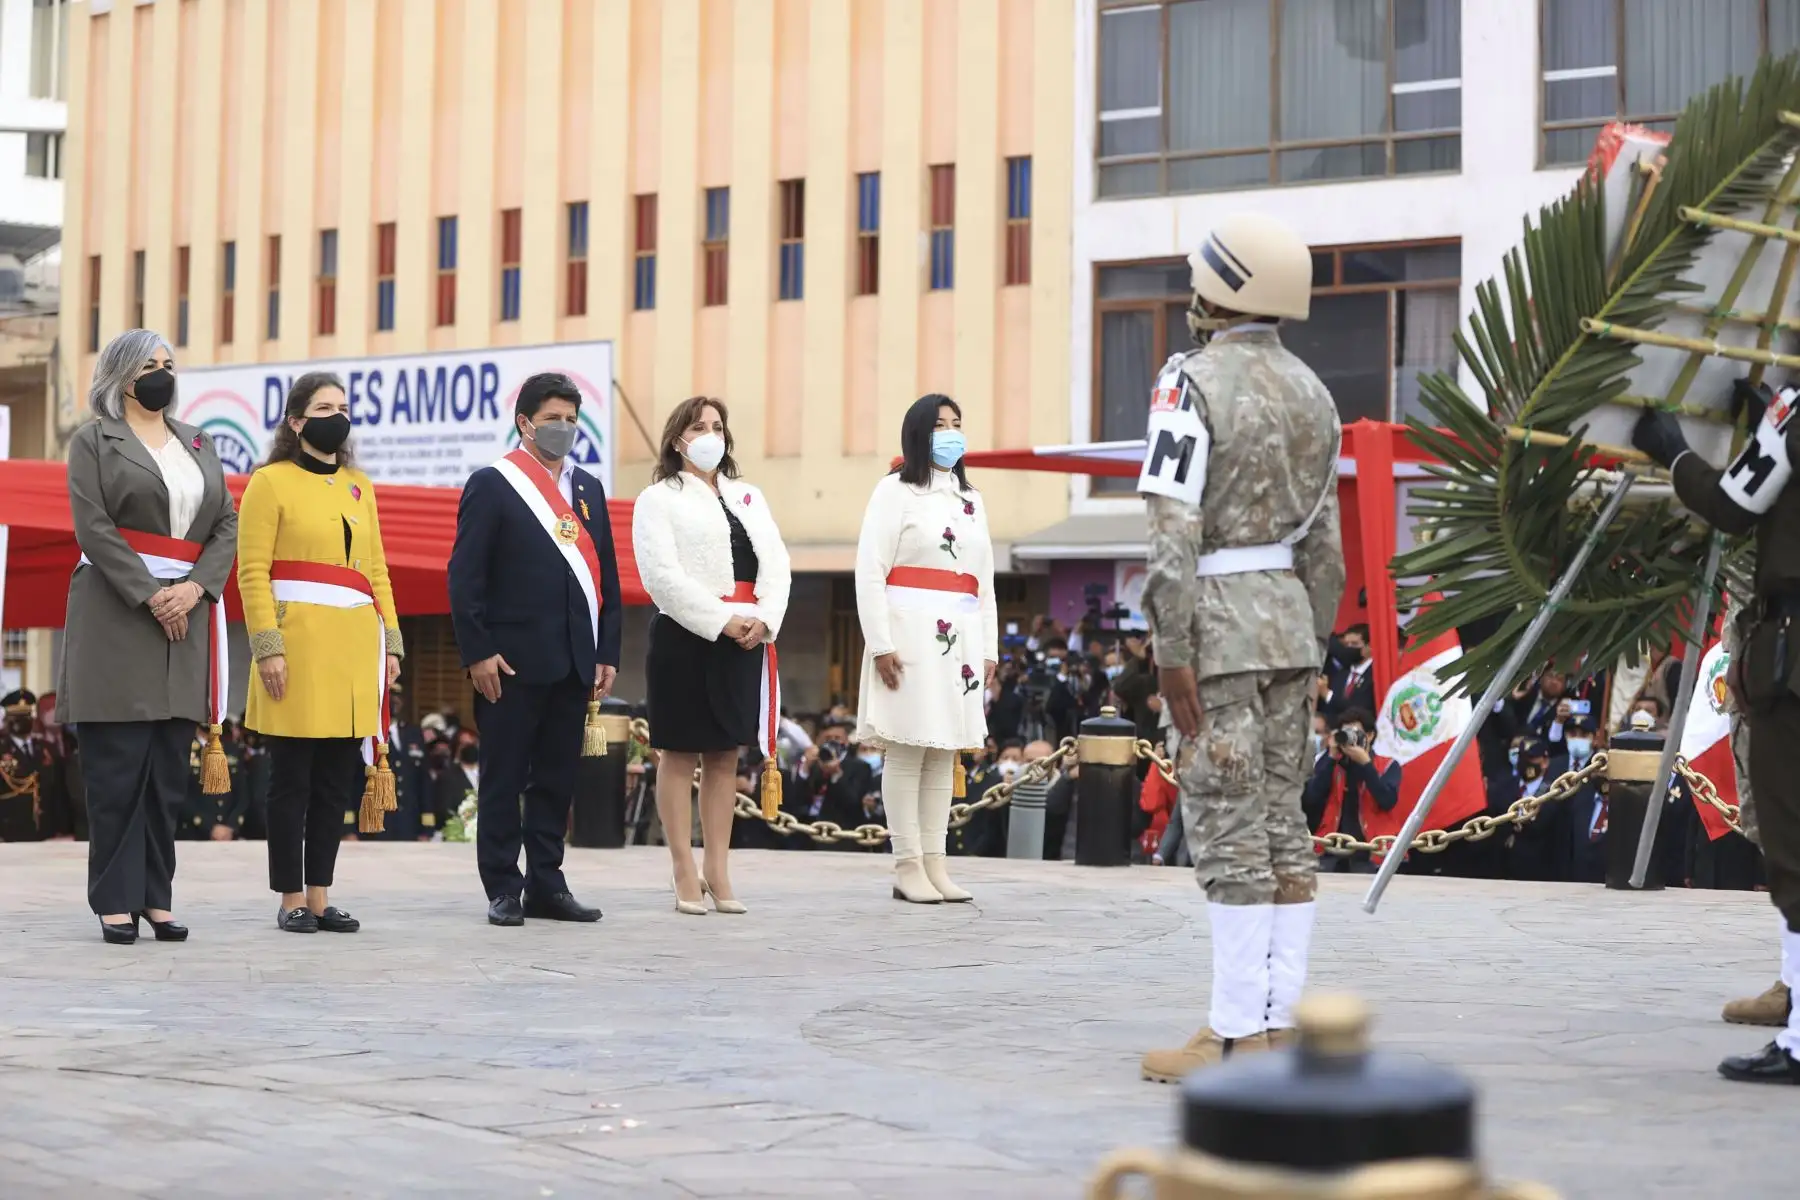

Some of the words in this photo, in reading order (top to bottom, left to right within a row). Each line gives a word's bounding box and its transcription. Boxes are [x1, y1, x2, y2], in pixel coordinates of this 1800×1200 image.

[349, 370, 383, 426] ES
[391, 362, 500, 424] AMOR
[1148, 429, 1197, 484] M
[1728, 439, 1777, 497] M
